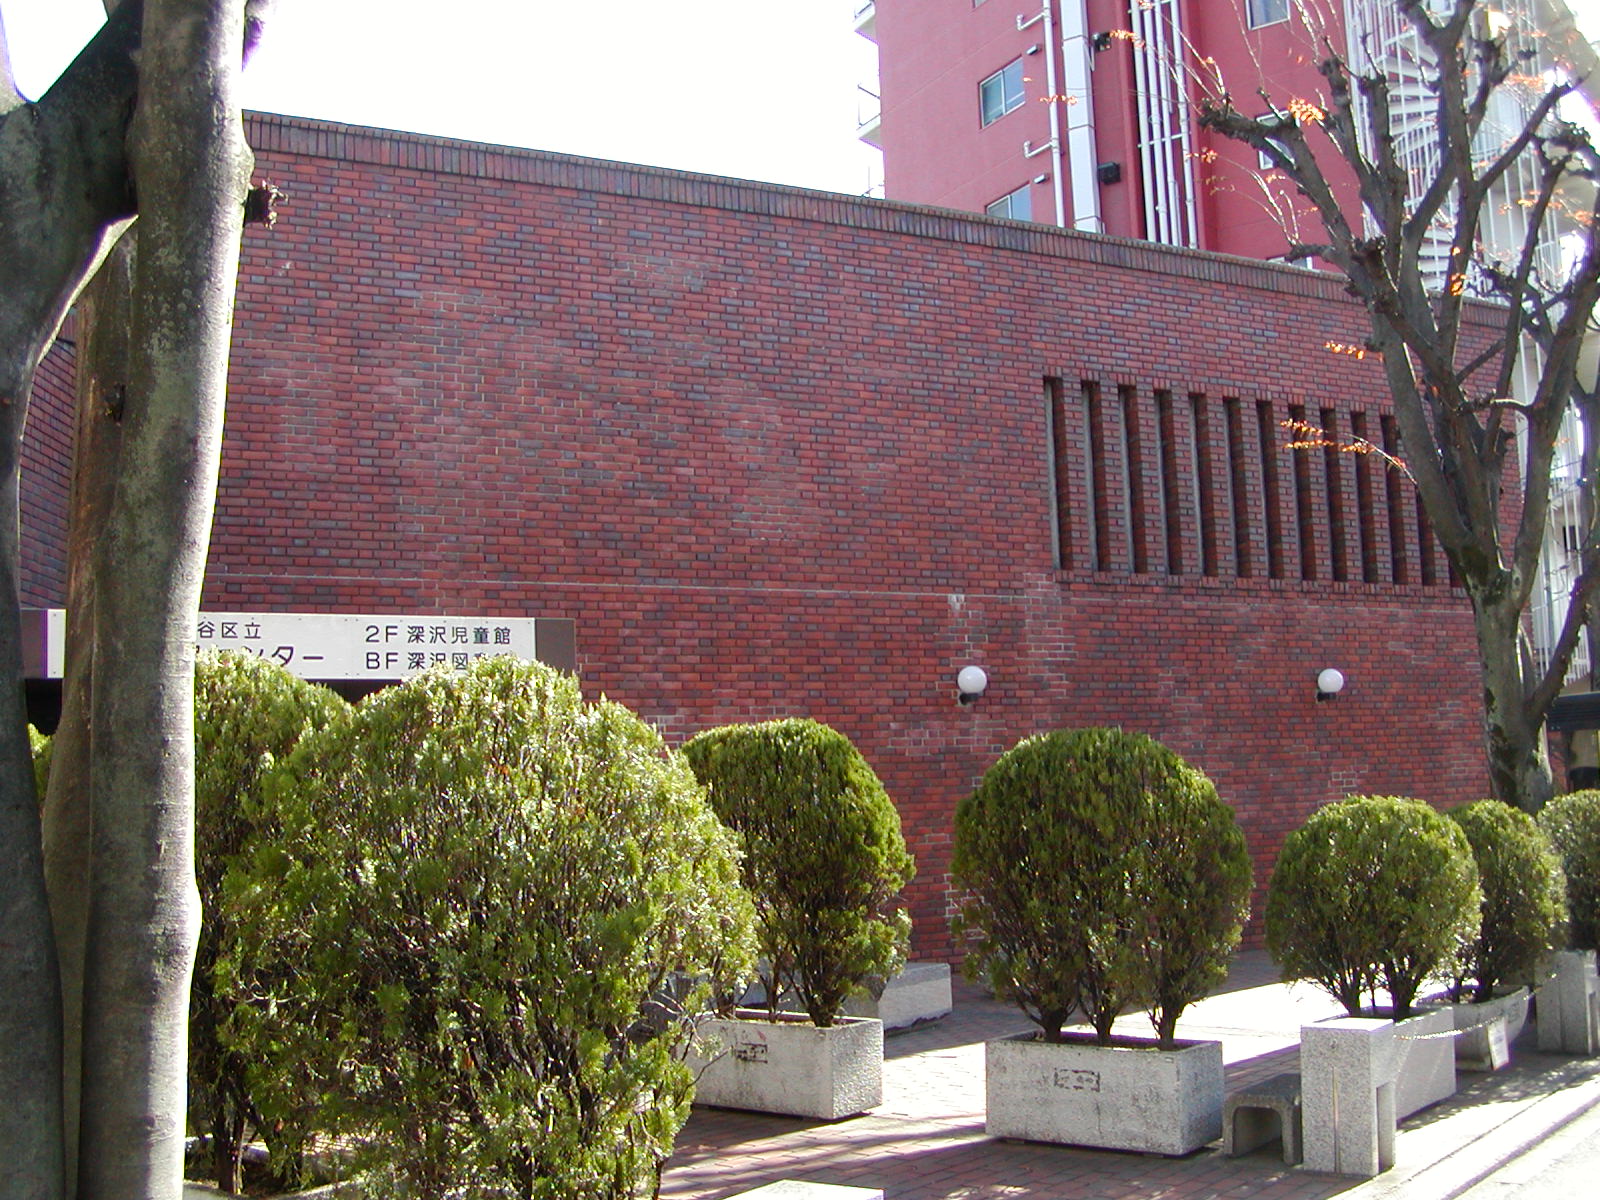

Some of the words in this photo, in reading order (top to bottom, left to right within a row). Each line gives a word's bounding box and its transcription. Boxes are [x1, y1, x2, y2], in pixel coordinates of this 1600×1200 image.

[365, 625, 399, 643] 2F
[407, 626, 511, 645] 深沢児童館
[365, 652, 399, 670] BF
[407, 652, 508, 670] 深沢図
